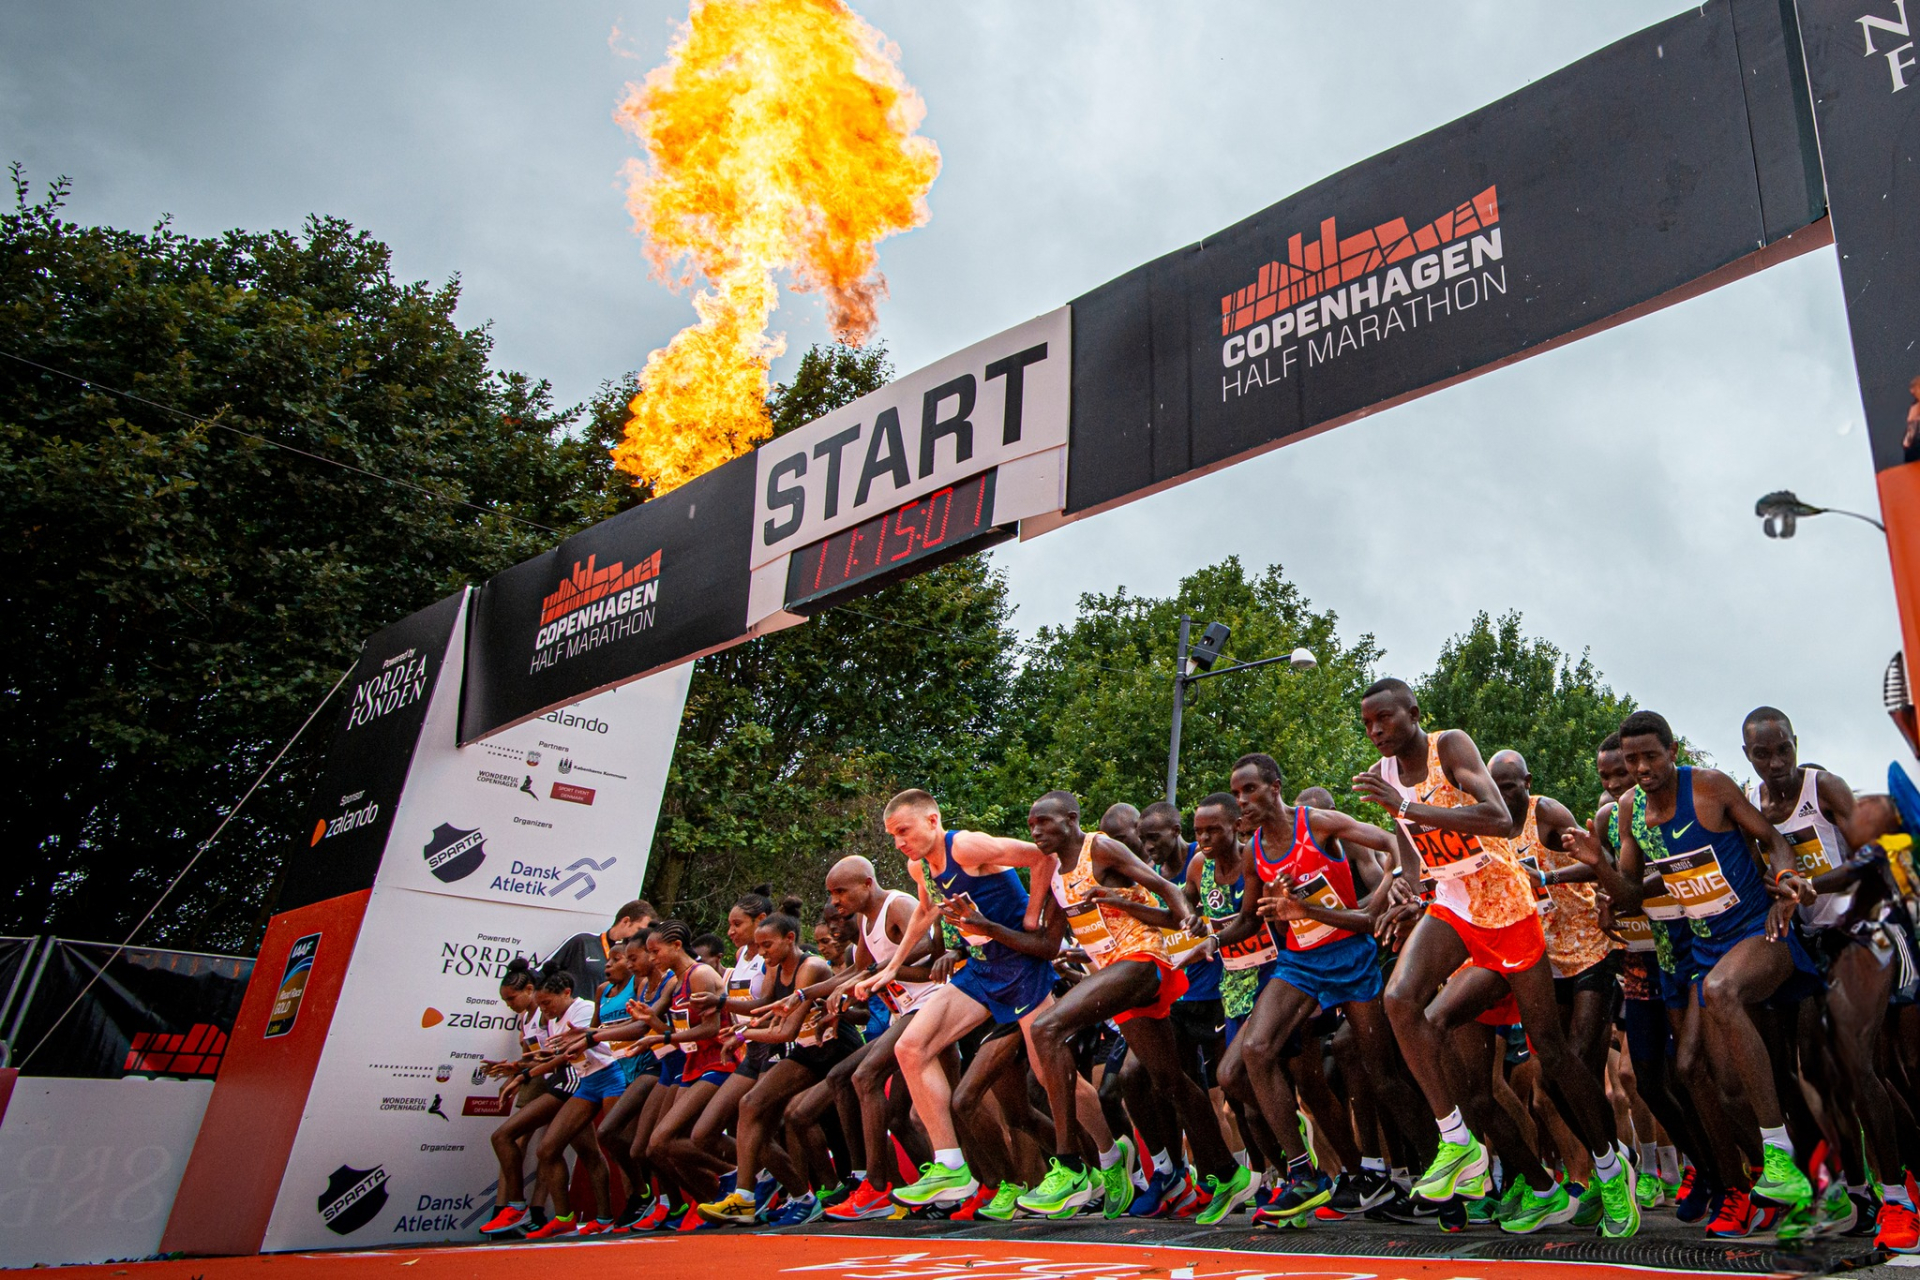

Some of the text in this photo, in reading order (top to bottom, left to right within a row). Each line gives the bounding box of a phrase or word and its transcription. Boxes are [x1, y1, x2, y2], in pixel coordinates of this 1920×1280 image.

[1222, 227, 1503, 368] COPENHAGEN
[1222, 265, 1507, 402] HALF MARATHON
[763, 341, 1048, 546] START
[535, 579, 659, 650] COPENHAGEN
[529, 606, 656, 675] HALF MARATHON
[352, 653, 427, 707] NORDEA
[346, 676, 428, 731] FONDEN
[538, 740, 570, 753] Partners
[476, 775, 518, 788] COPENHAGEN
[479, 770, 519, 783] WONDERFUL
[339, 789, 366, 807] Sponsor
[558, 785, 575, 793] SPORT
[325, 800, 379, 839] zalando
[513, 816, 553, 829] Organizers
[1798, 809, 1818, 818] adidas
[428, 831, 483, 868] SPARTA
[510, 860, 562, 881] Dansk
[489, 875, 548, 897] Atletik
[477, 933, 522, 945] Powered by
[441, 942, 541, 967] NORDEA
[274, 999, 291, 1015] GOLD
[465, 996, 499, 1006] Sponsor
[449, 1051, 485, 1060] Partners
[382, 1096, 428, 1105] WONDERFUL
[420, 1143, 465, 1153] Organizers
[323, 1168, 386, 1221] SPARTA
[416, 1193, 475, 1212] Dansk
[392, 1215, 459, 1233] Atletik
